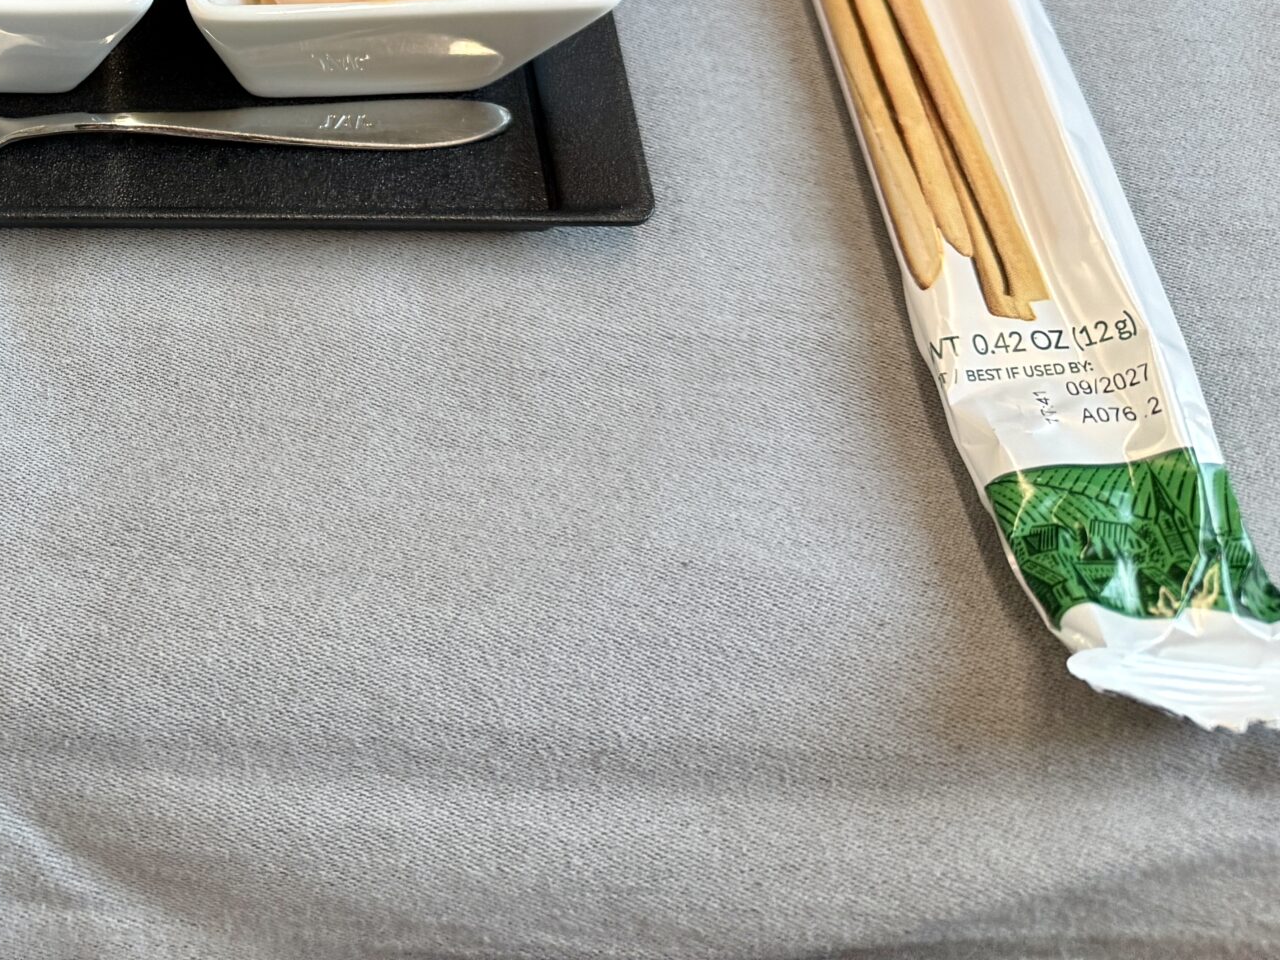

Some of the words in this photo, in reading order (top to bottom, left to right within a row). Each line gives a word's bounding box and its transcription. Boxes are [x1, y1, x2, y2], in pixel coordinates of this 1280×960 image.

[971, 329, 1027, 356] 0.42
[1030, 329, 1070, 351] OZ
[965, 368, 1003, 382] BEST
[1004, 366, 1020, 380] IF
[1022, 362, 1066, 378] USED
[1067, 360, 1095, 375] BY:
[1065, 362, 1149, 397] 09/2027
